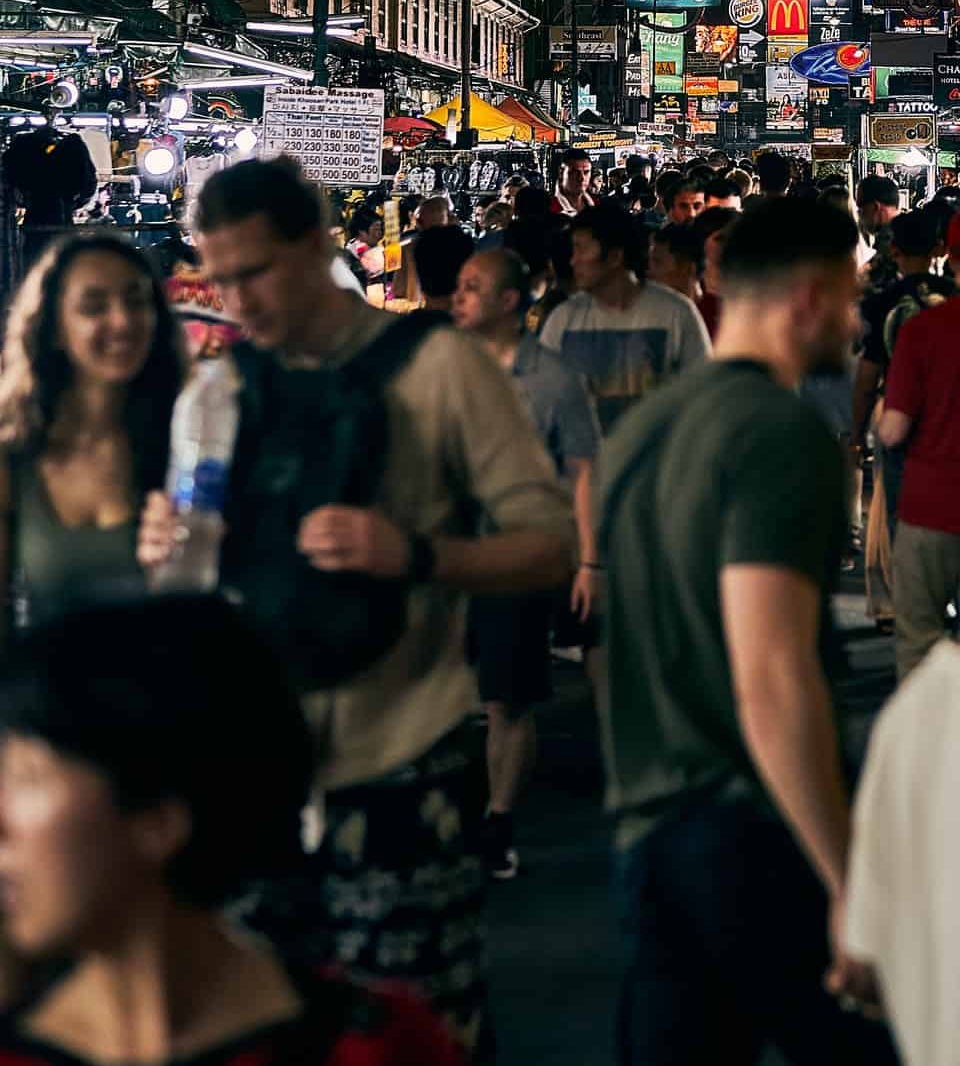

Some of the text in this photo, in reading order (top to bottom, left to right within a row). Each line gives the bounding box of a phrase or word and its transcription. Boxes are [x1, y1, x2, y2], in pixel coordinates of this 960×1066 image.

[735, 4, 759, 19] KING
[275, 86, 374, 99] Sabaidee Massage
[286, 127, 303, 138] 130
[305, 128, 322, 138] 130
[284, 141, 302, 151] 230
[304, 141, 322, 151] 230
[323, 142, 341, 152] 330
[343, 143, 361, 153] 300
[322, 156, 340, 166] 500
[342, 157, 360, 167] 400
[342, 170, 359, 180] 500
[361, 164, 378, 175] 250
